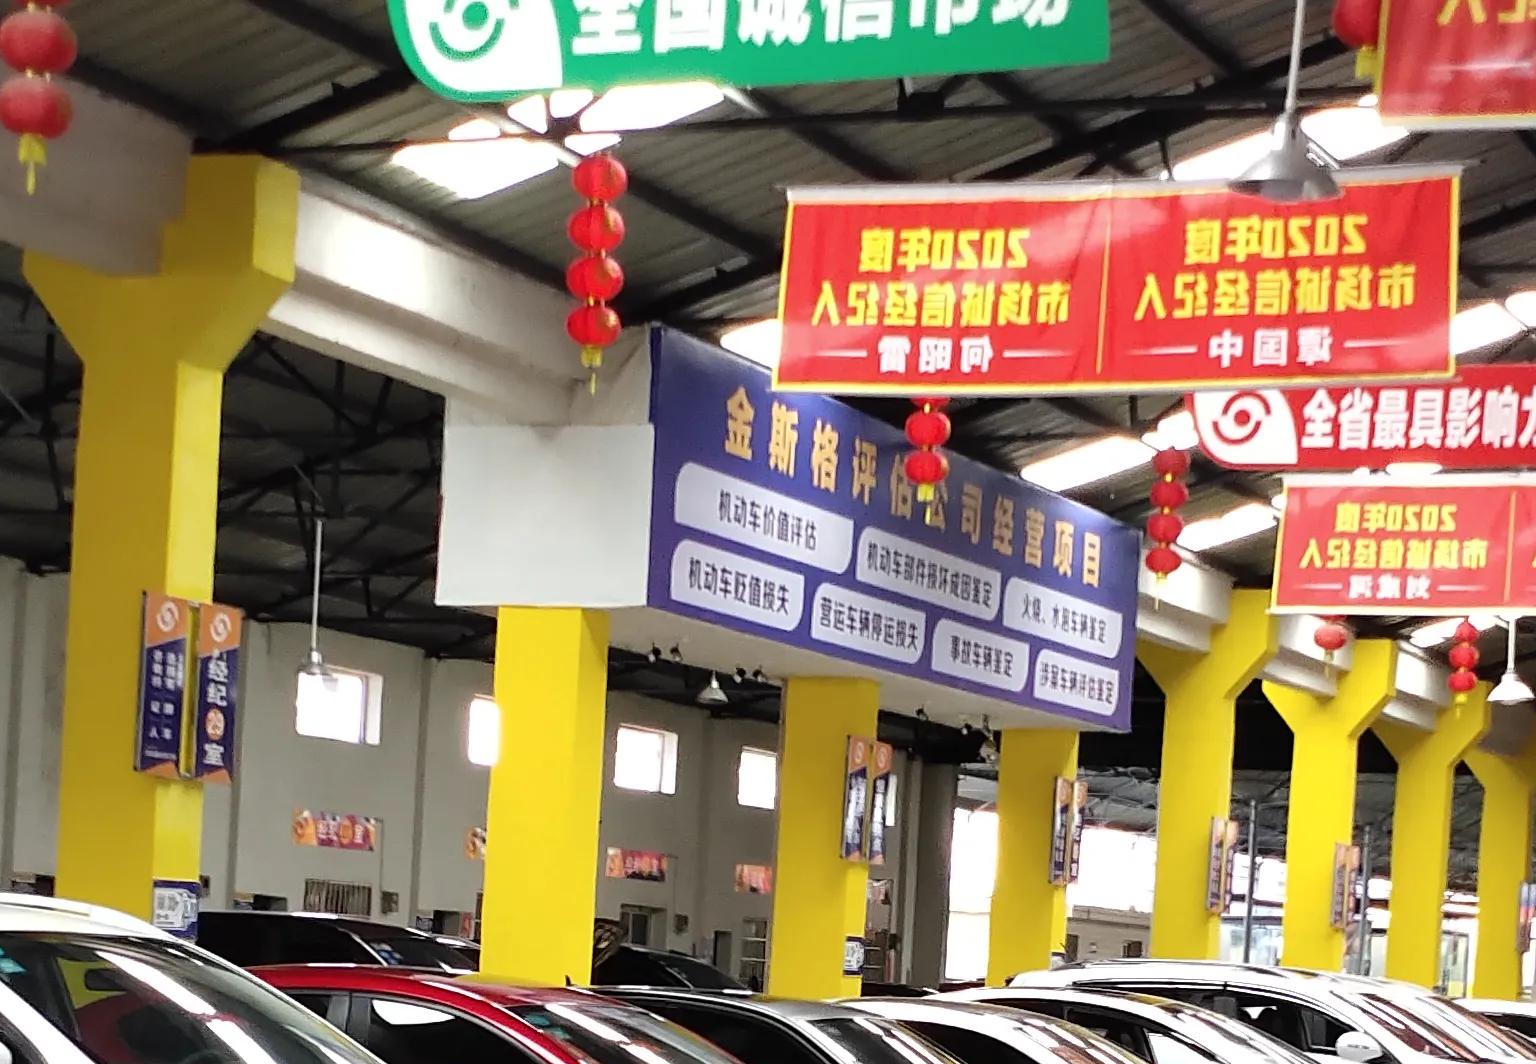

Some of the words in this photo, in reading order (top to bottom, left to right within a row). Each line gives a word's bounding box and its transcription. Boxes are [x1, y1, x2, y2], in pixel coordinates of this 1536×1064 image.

[724, 385, 1101, 588] 金斯格评估公司经营项目
[718, 491, 817, 553] 机动车价值评估
[688, 557, 790, 617] 机动车贬值损失
